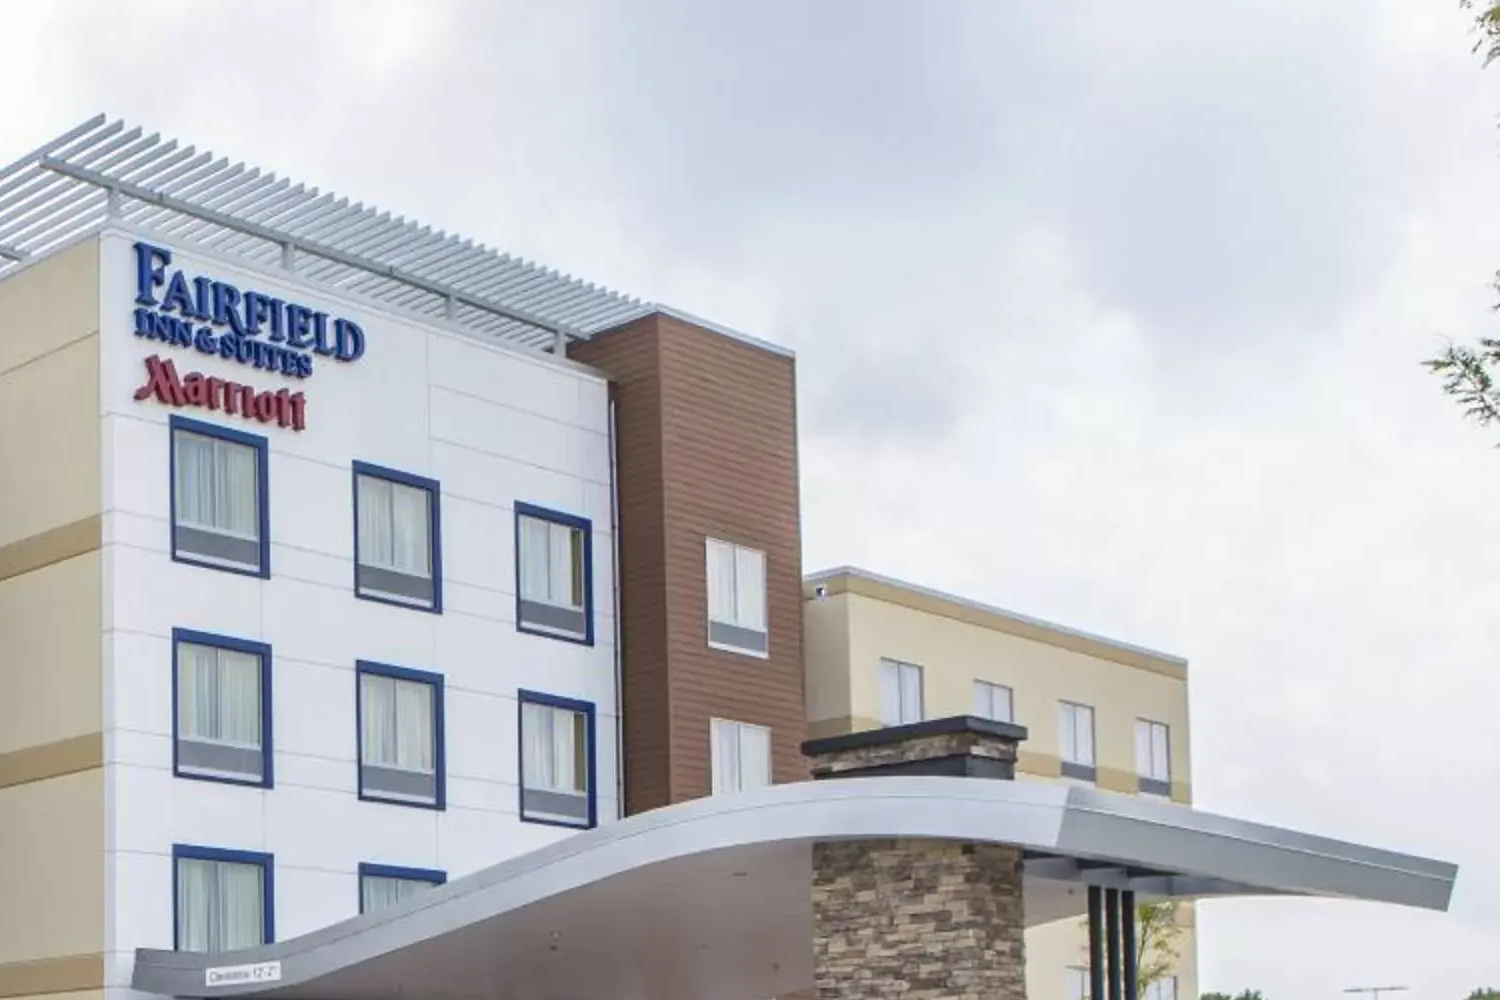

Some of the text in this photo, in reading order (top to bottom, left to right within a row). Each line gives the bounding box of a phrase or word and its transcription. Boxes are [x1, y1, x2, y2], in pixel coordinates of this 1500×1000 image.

[134, 242, 366, 362] FAIRFIELD
[134, 308, 313, 379] INN & SUITES
[133, 354, 306, 432] Marriott
